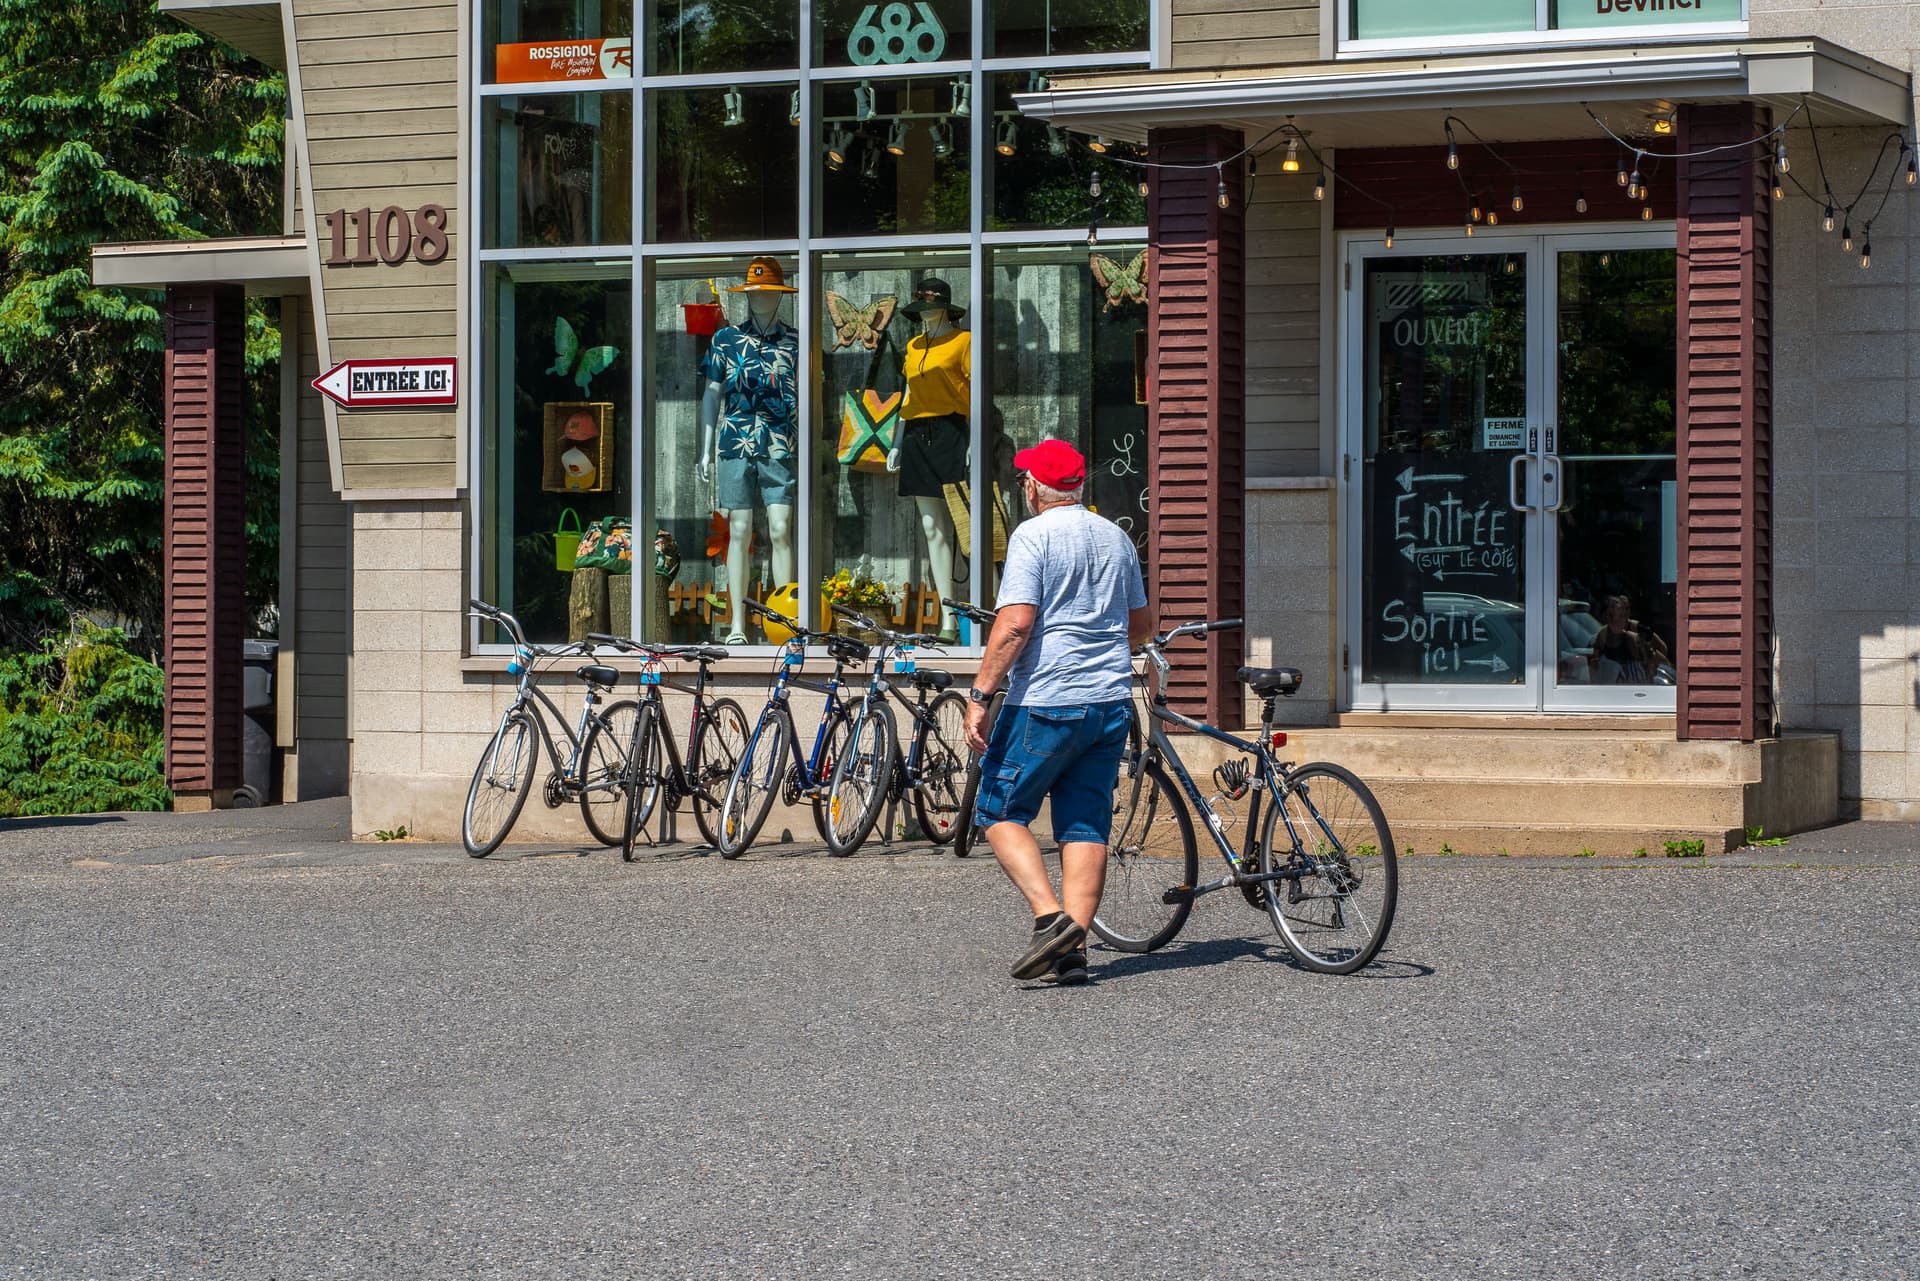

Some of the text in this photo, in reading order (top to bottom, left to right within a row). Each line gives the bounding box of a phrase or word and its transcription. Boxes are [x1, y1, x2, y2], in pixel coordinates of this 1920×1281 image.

[847, 2, 946, 66] 686
[529, 44, 597, 60] ROSSIGNOL
[325, 203, 449, 266] 1108
[1393, 317, 1485, 347] OUVERT
[352, 366, 447, 391] ENTRÉE ICI
[1487, 418, 1525, 430] FERMÉ
